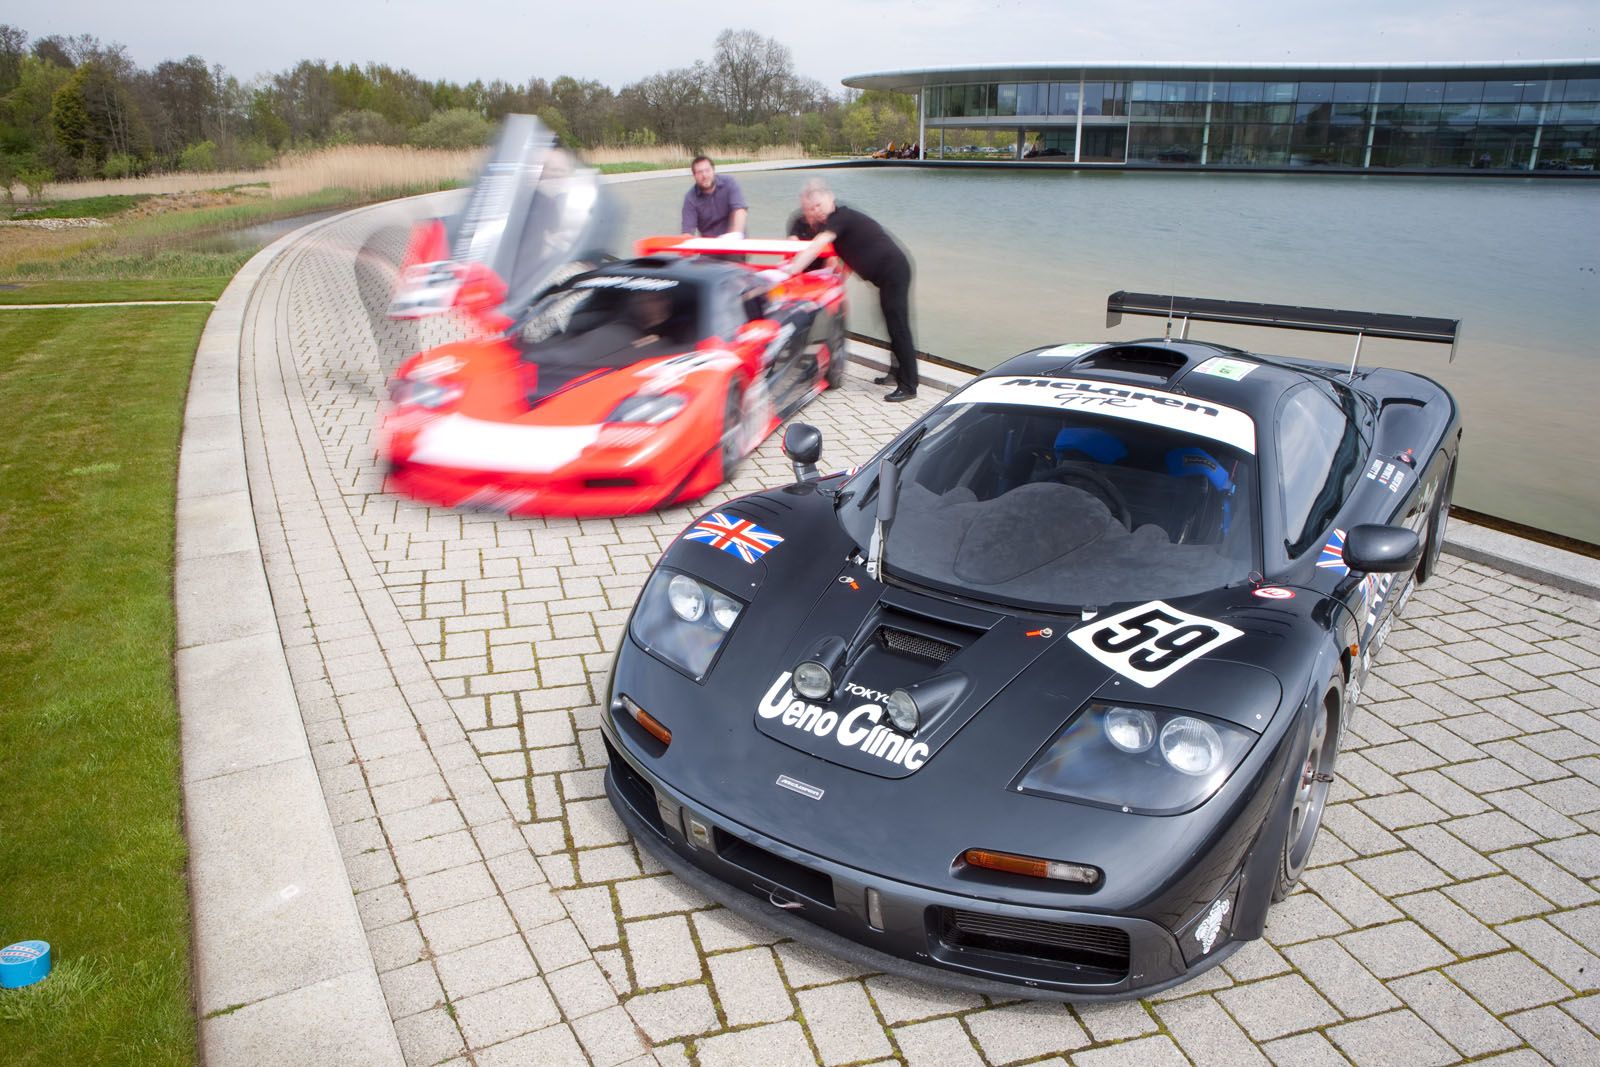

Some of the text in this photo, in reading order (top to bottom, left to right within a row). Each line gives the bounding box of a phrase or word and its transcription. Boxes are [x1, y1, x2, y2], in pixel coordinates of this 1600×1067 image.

[1000, 378, 1219, 417] McLaren
[1054, 393, 1137, 408] GTR
[1091, 608, 1220, 672] 59
[758, 671, 930, 770] Ueno Clinic
